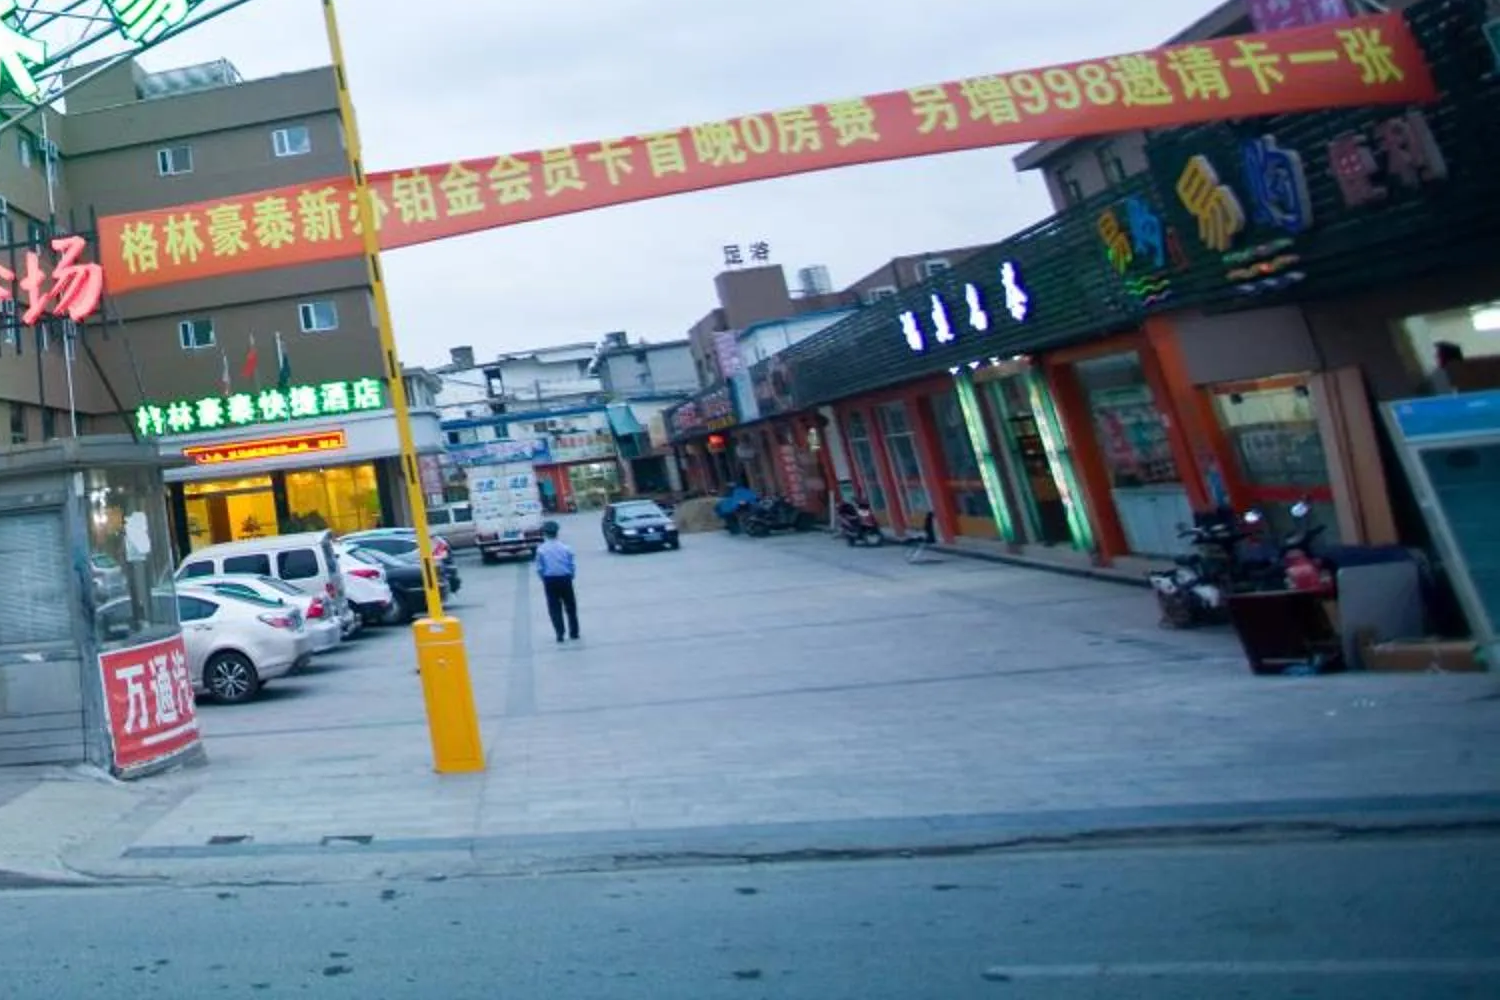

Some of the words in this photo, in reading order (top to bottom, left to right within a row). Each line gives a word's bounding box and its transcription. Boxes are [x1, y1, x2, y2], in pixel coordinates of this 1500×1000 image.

[136, 378, 383, 437] 格林豪泰快捷酒店
